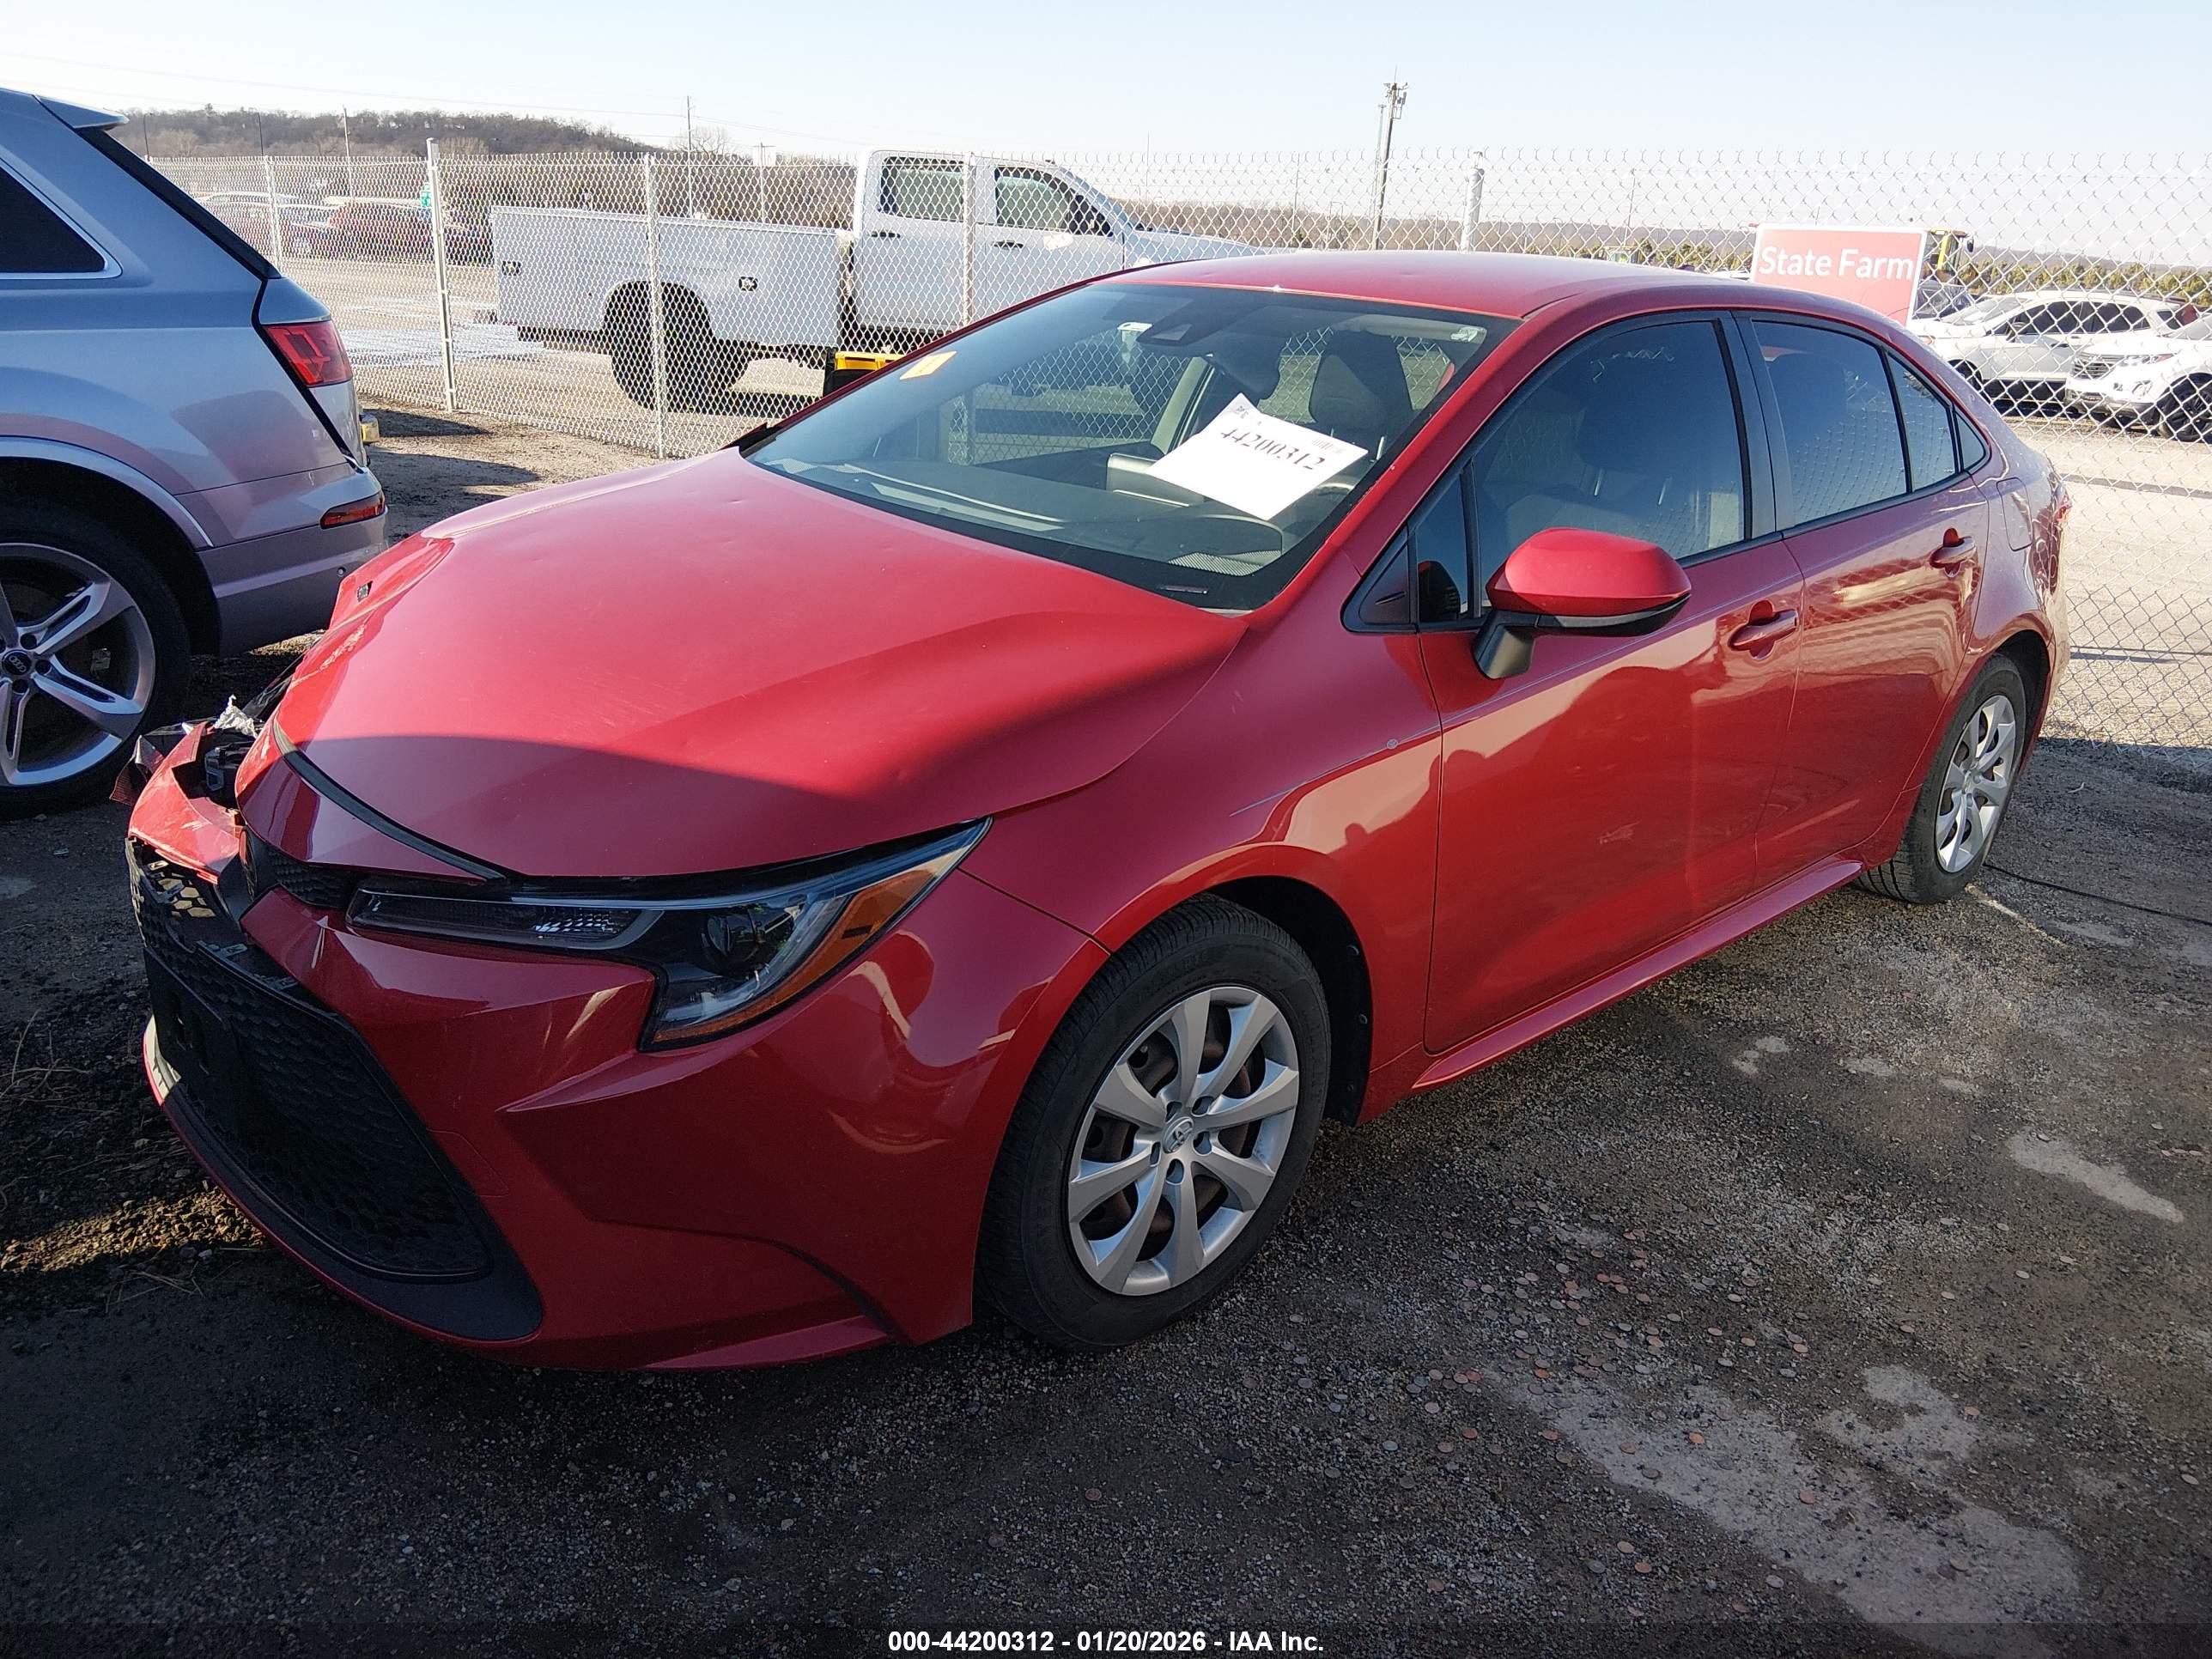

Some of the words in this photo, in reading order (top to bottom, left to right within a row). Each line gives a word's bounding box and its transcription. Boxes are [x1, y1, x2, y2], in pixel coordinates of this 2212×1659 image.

[1759, 246, 1832, 276] State
[1838, 248, 1914, 280] Farm
[1220, 428, 1326, 470] 44200312
